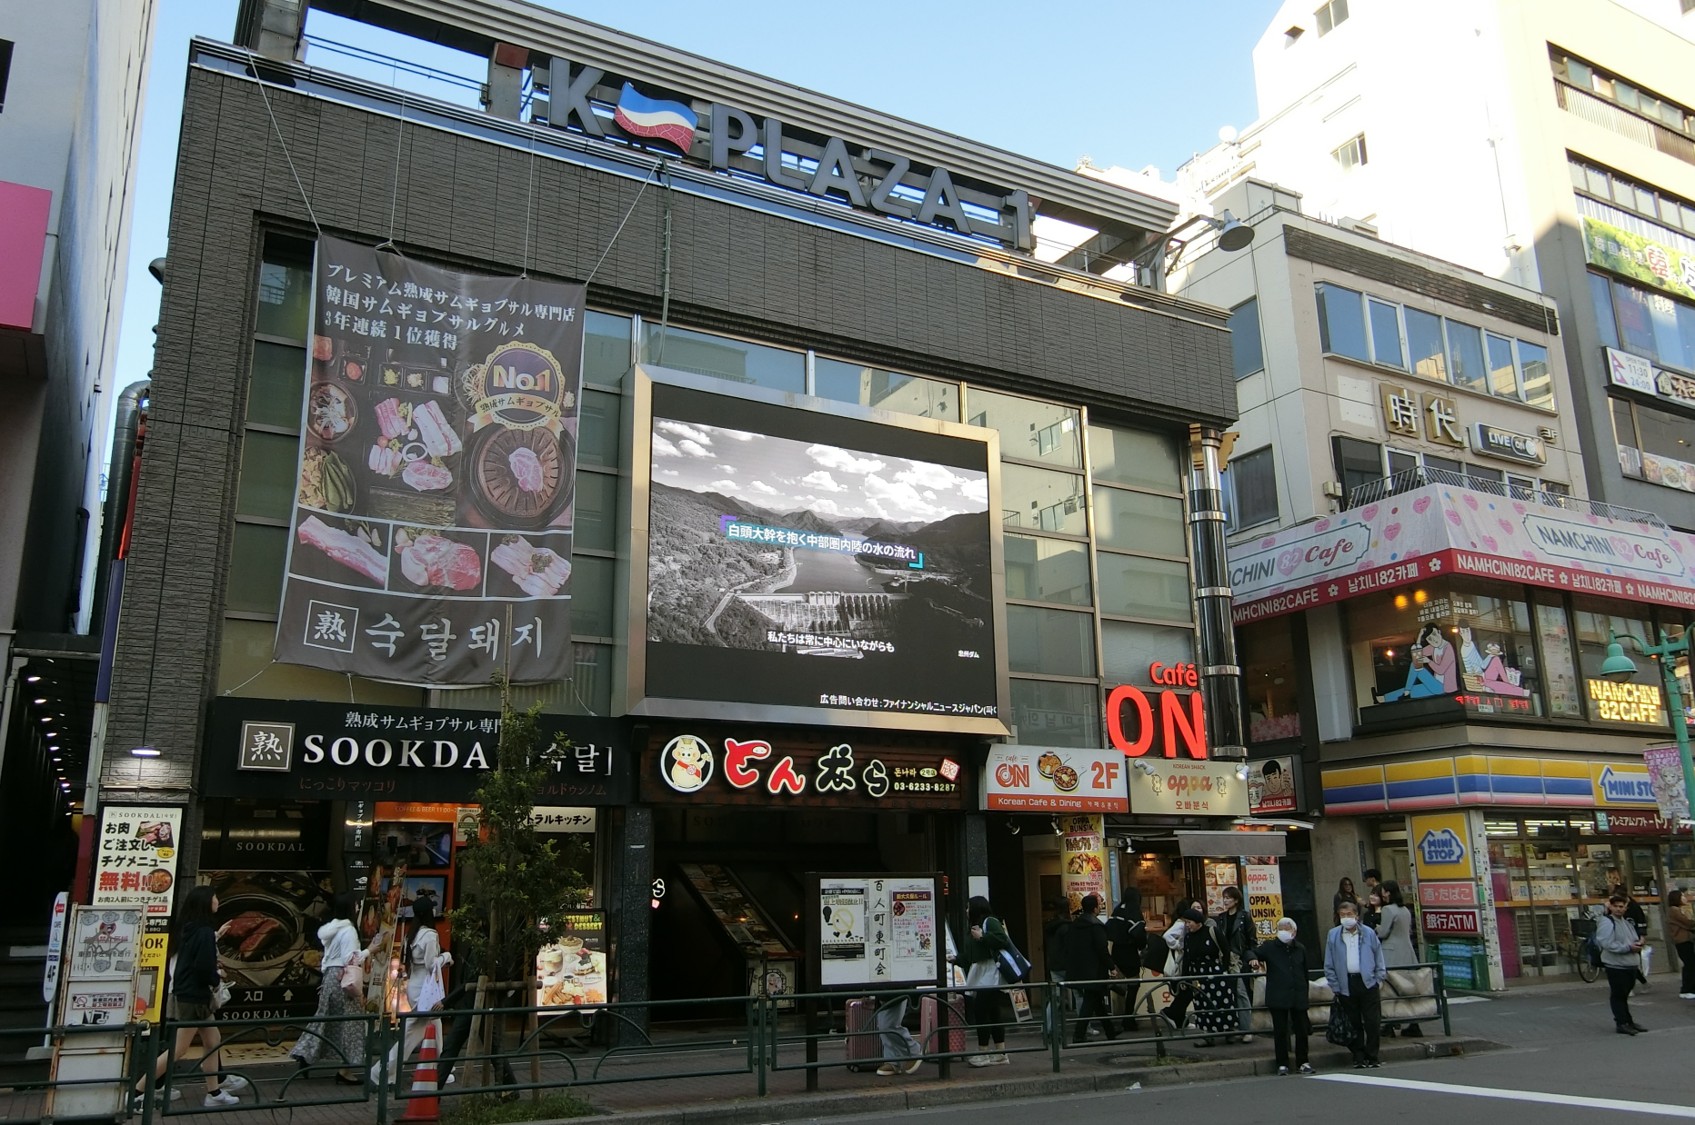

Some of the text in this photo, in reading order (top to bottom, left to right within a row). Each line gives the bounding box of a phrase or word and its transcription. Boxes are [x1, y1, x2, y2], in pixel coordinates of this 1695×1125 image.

[548, 57, 1036, 252] K PLAZA 1
[325, 284, 525, 338] 韓国サムギョプサルグルメ
[1389, 388, 1464, 444] 時代
[1488, 431, 1512, 447] LIVE
[1536, 525, 1616, 556] NAMCHINI
[1633, 543, 1672, 569] Cafe
[1228, 538, 1354, 588] CHINI 82 Cafe
[1457, 553, 1556, 584] NAMHCINI82CAFE
[313, 609, 347, 644] 熟
[767, 630, 896, 653] 私たちは常に中心にいながらも
[1149, 661, 1199, 687] Café
[1589, 680, 1662, 706] NAMCHINI
[1107, 684, 1208, 759] ON
[1600, 700, 1658, 723] 82CAFE
[344, 711, 524, 734] 熟成サムギョプサル専
[250, 730, 284, 762] 熟
[303, 733, 515, 771] SOOKDA
[995, 763, 1030, 788] ON
[1091, 760, 1119, 790] 2F
[536, 782, 607, 796] ョルドゥンノム
[894, 781, 956, 792] 03-6233-8287
[1167, 774, 1213, 797] oppa
[1608, 780, 1635, 796] MINI
[998, 797, 1082, 808] Korean Cafe & Dining
[1175, 800, 1209, 811] 오빠분식
[118, 811, 161, 819] SOOKDAL
[1072, 817, 1090, 825] OPPA
[105, 822, 131, 835] お肉
[236, 841, 305, 852] SOOKDAL
[1428, 838, 1453, 849] MINI
[101, 855, 170, 868] チゲメニュー
[1427, 849, 1455, 860] STOP
[1249, 896, 1271, 906] OPPA
[1250, 908, 1276, 918] UNSIK
[1426, 913, 1475, 930] 銀行ATM
[243, 990, 263, 1002] 入口
[222, 1009, 290, 1021] SOOKDAL
